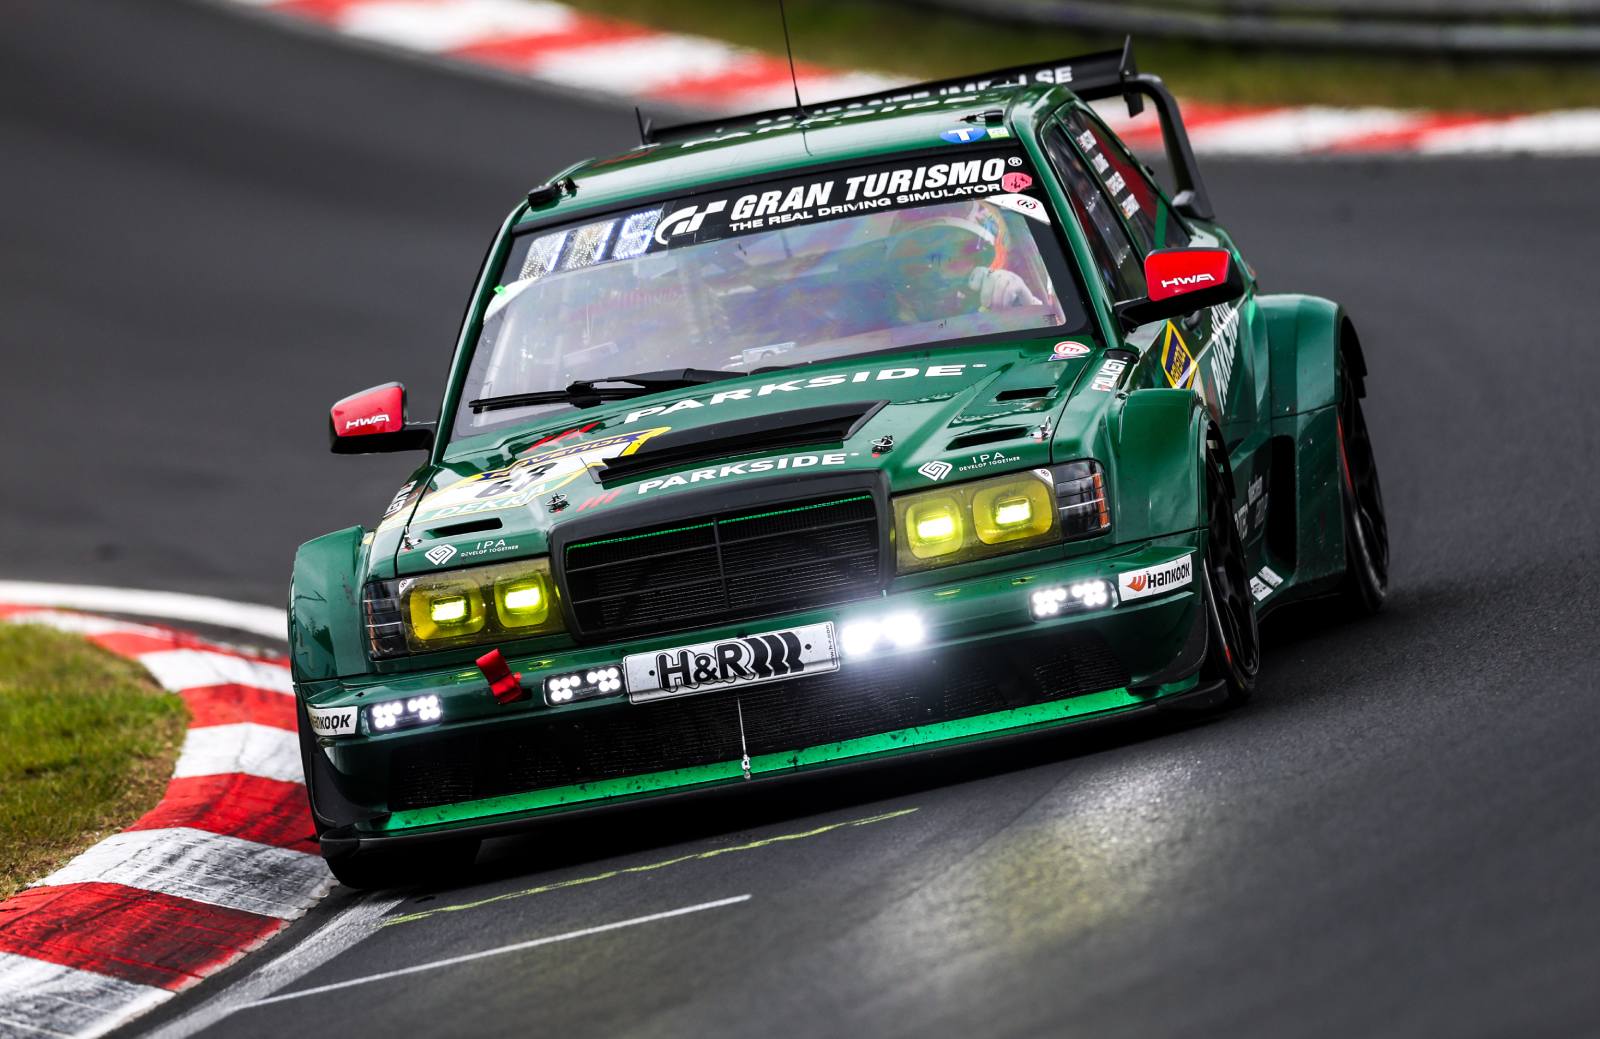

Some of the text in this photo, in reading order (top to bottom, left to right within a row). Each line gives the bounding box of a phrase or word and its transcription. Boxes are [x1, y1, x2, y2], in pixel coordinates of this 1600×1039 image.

[729, 183, 1001, 232] THE REAL DRIVING SIMULATOR
[730, 181, 834, 221] GRAN
[1160, 273, 1216, 288] HWA
[623, 364, 966, 424] PARKSIDE
[345, 413, 390, 430] HWA
[959, 456, 1020, 472] DEVELOP TOGETHER
[972, 451, 1005, 464] IPA
[637, 453, 848, 494] PARKSIDE
[476, 539, 506, 550] IPA
[489, 545, 519, 553] TOGETHER
[657, 643, 752, 692] H&R
